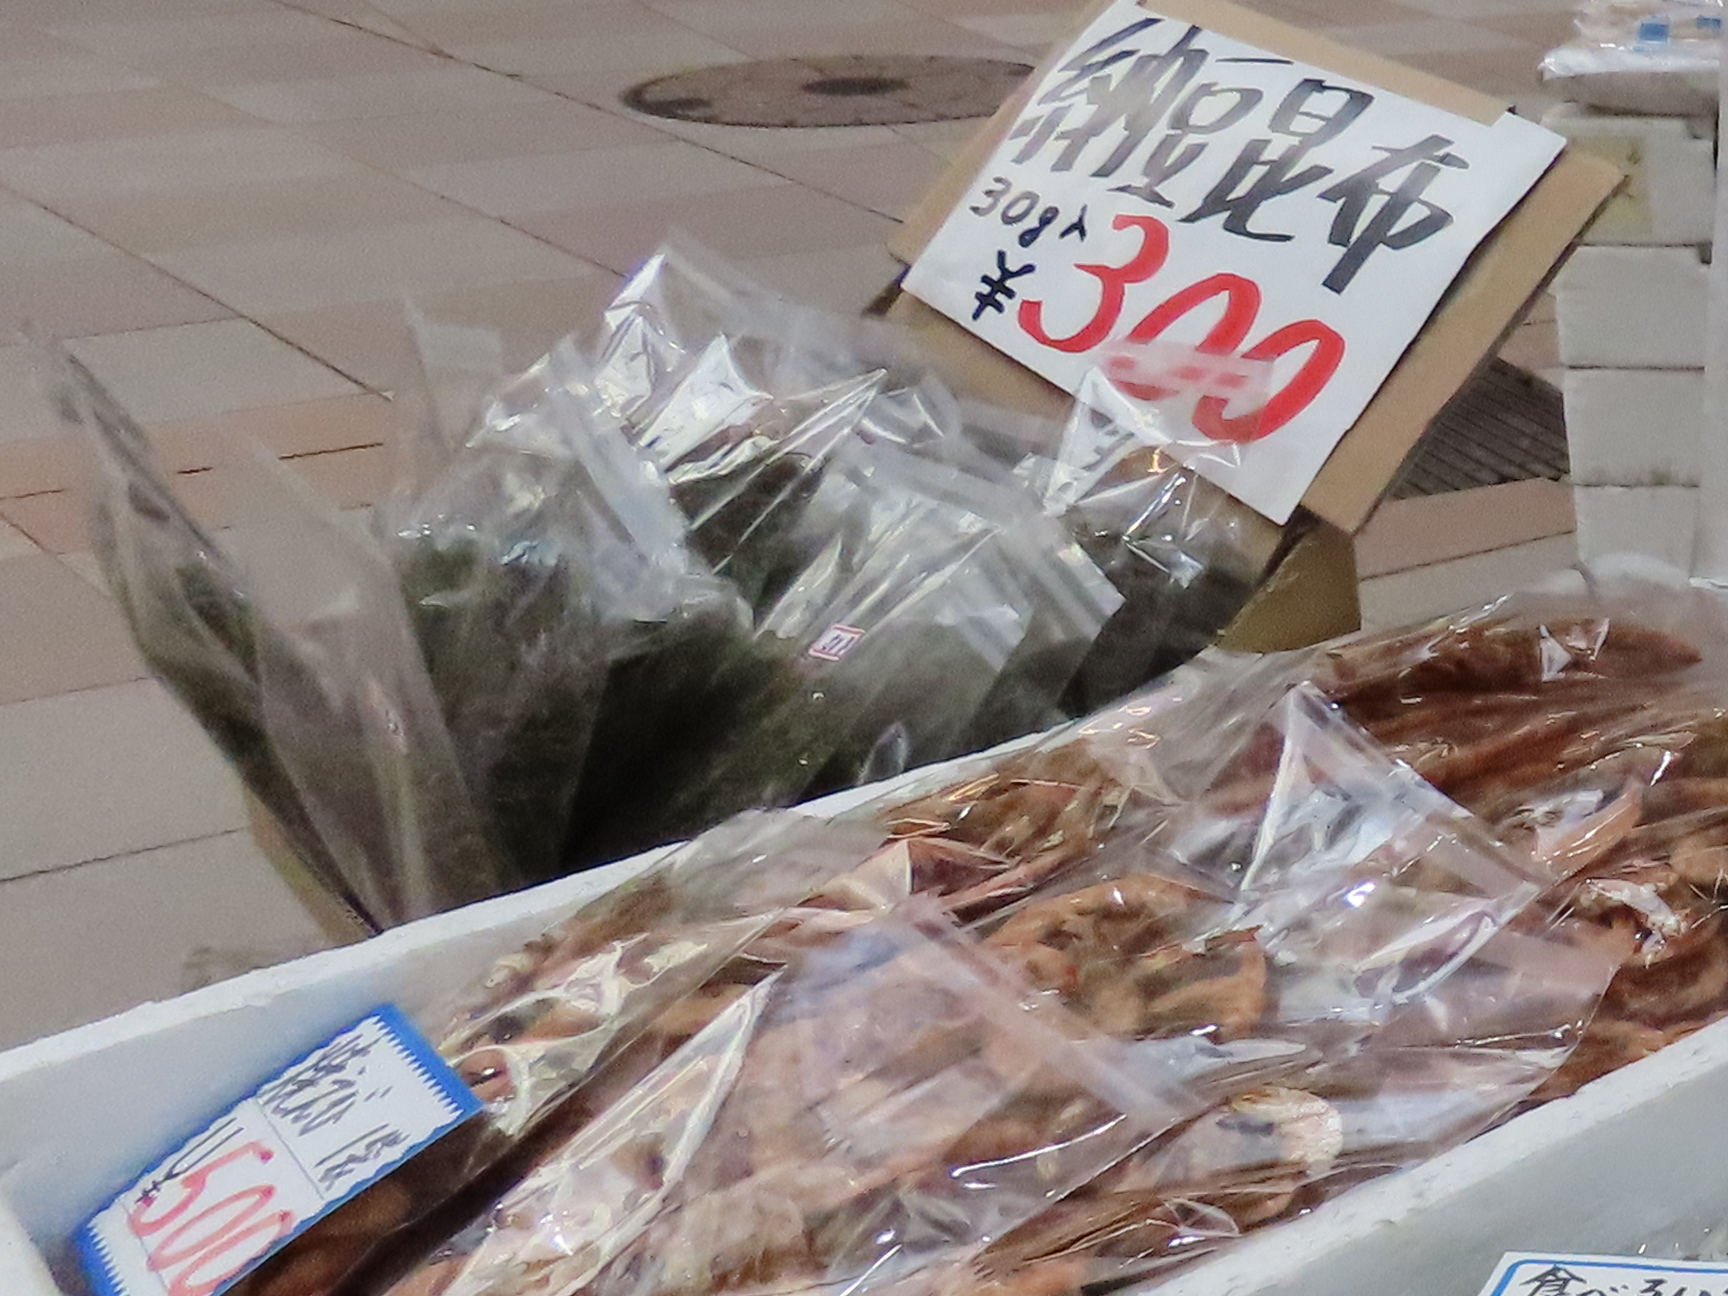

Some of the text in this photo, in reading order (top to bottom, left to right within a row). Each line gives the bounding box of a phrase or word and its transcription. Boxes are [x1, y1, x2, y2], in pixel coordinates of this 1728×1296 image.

[968, 175, 1092, 249] 30g入
[1008, 16, 1472, 296] 納豆昆布
[970, 212, 1348, 447] ¥300
